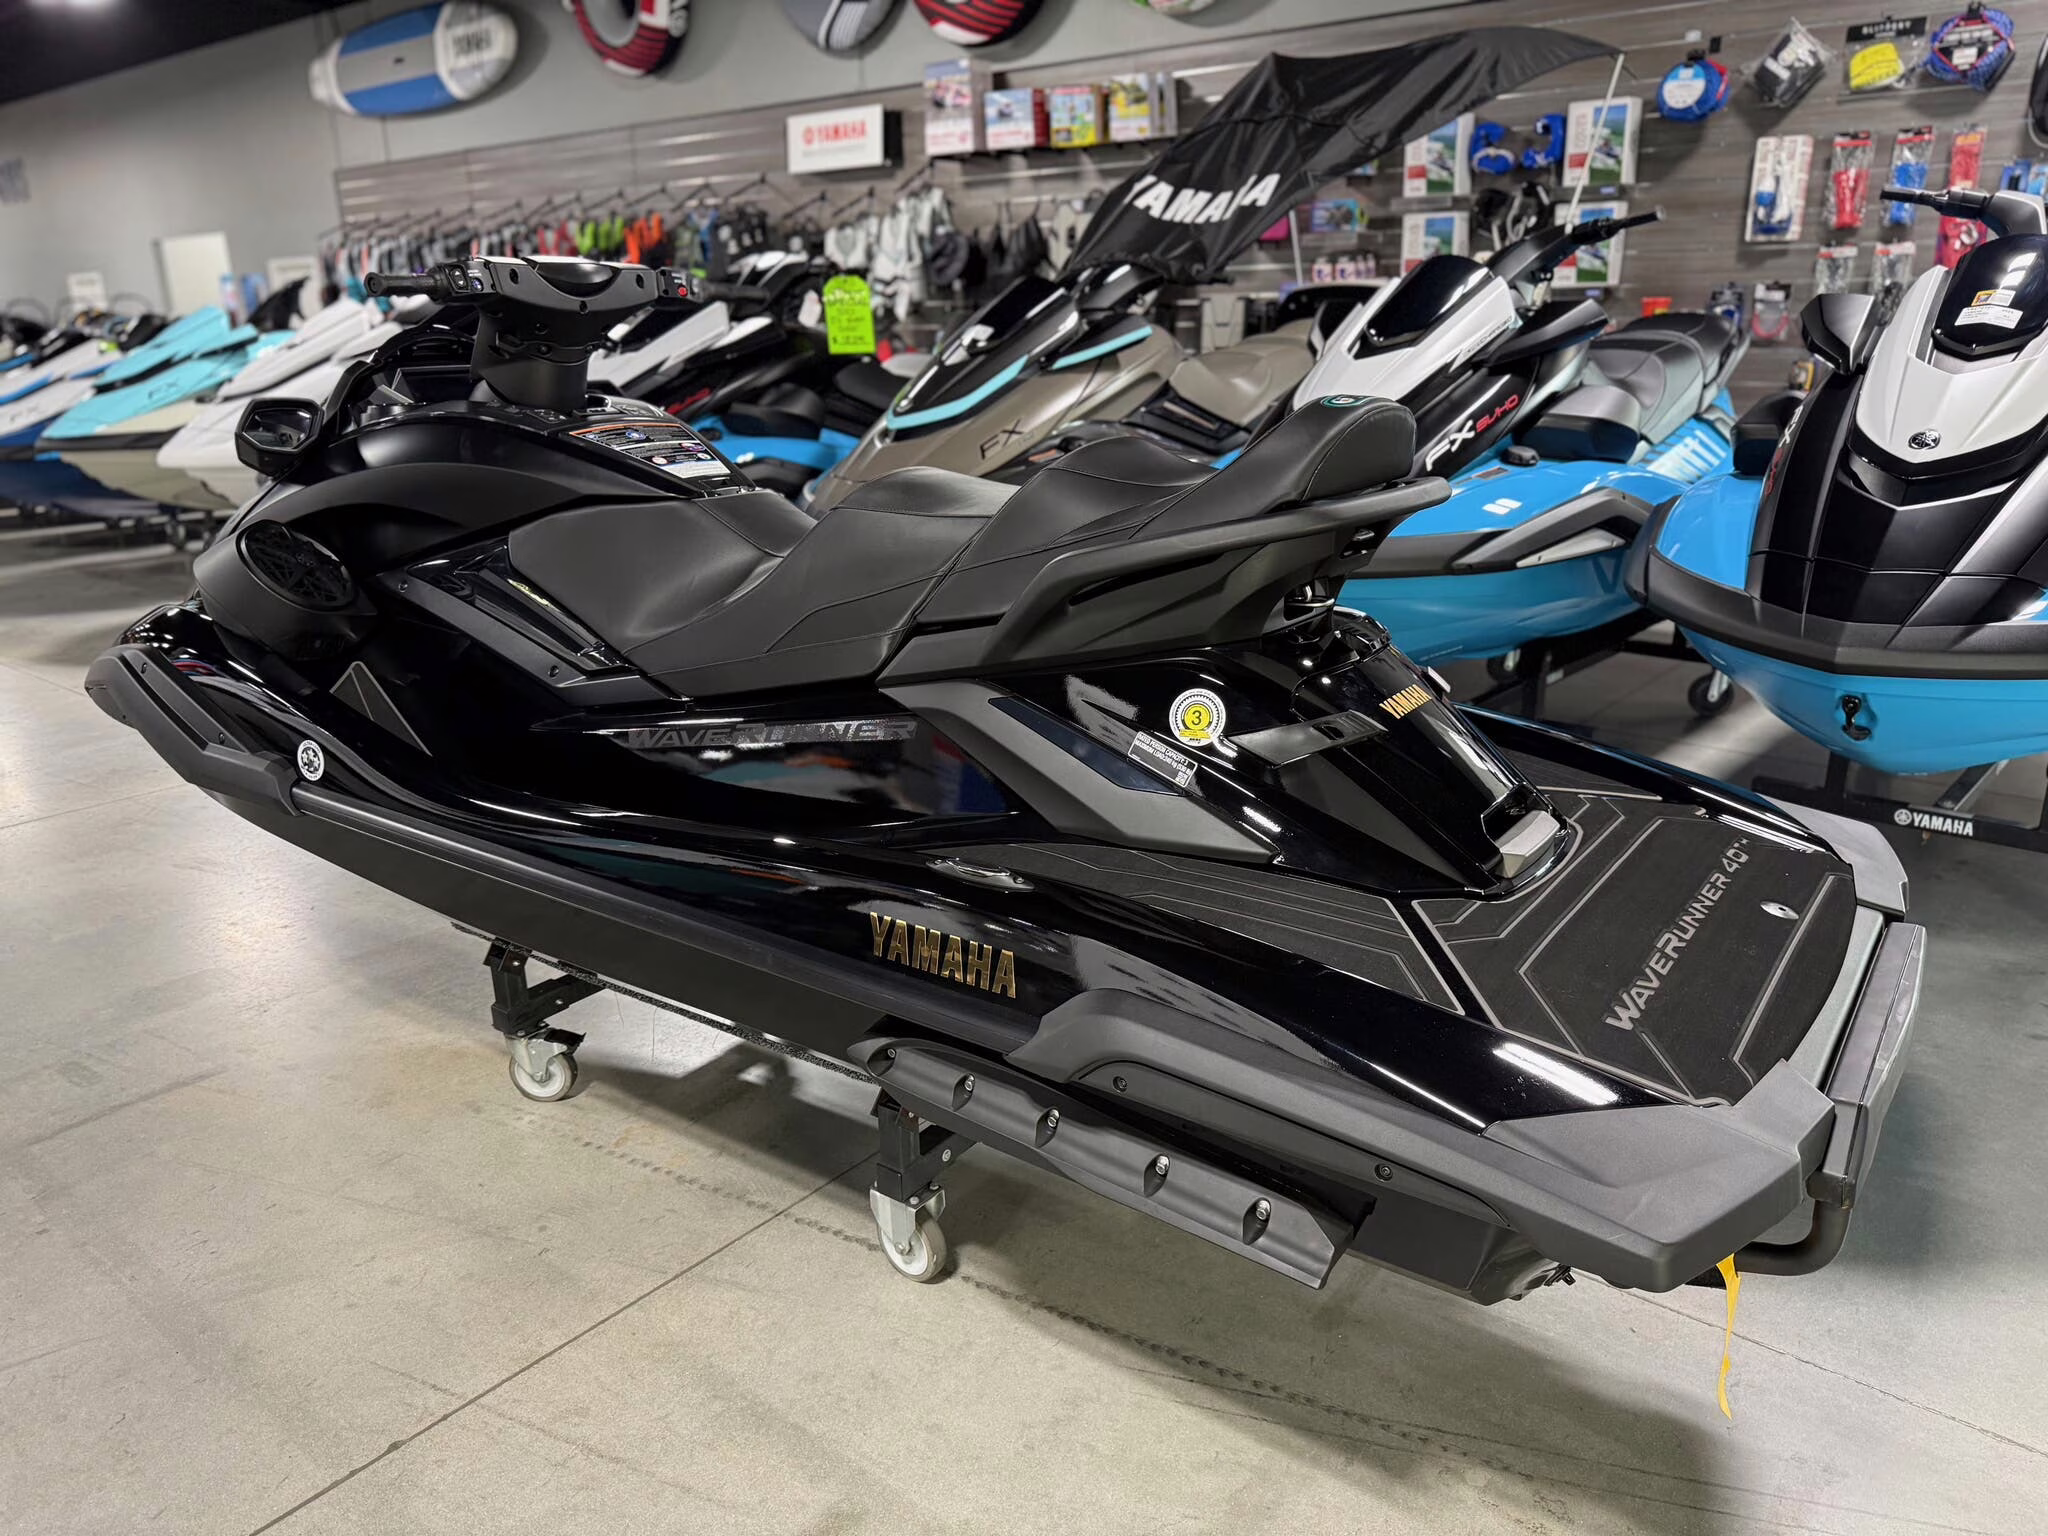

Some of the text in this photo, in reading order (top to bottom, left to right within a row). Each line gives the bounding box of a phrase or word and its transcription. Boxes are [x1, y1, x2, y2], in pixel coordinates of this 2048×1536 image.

[817, 119, 868, 145] YAMAHA
[979, 418, 1024, 461] FX
[1424, 419, 1476, 472] FX
[1191, 709, 1203, 726] 3
[1378, 683, 1433, 720] YAMAHA
[1911, 811, 1974, 837] YAMAHA
[869, 911, 1017, 999] YAMAHA
[1603, 871, 1732, 1032] WAVERUNNER
